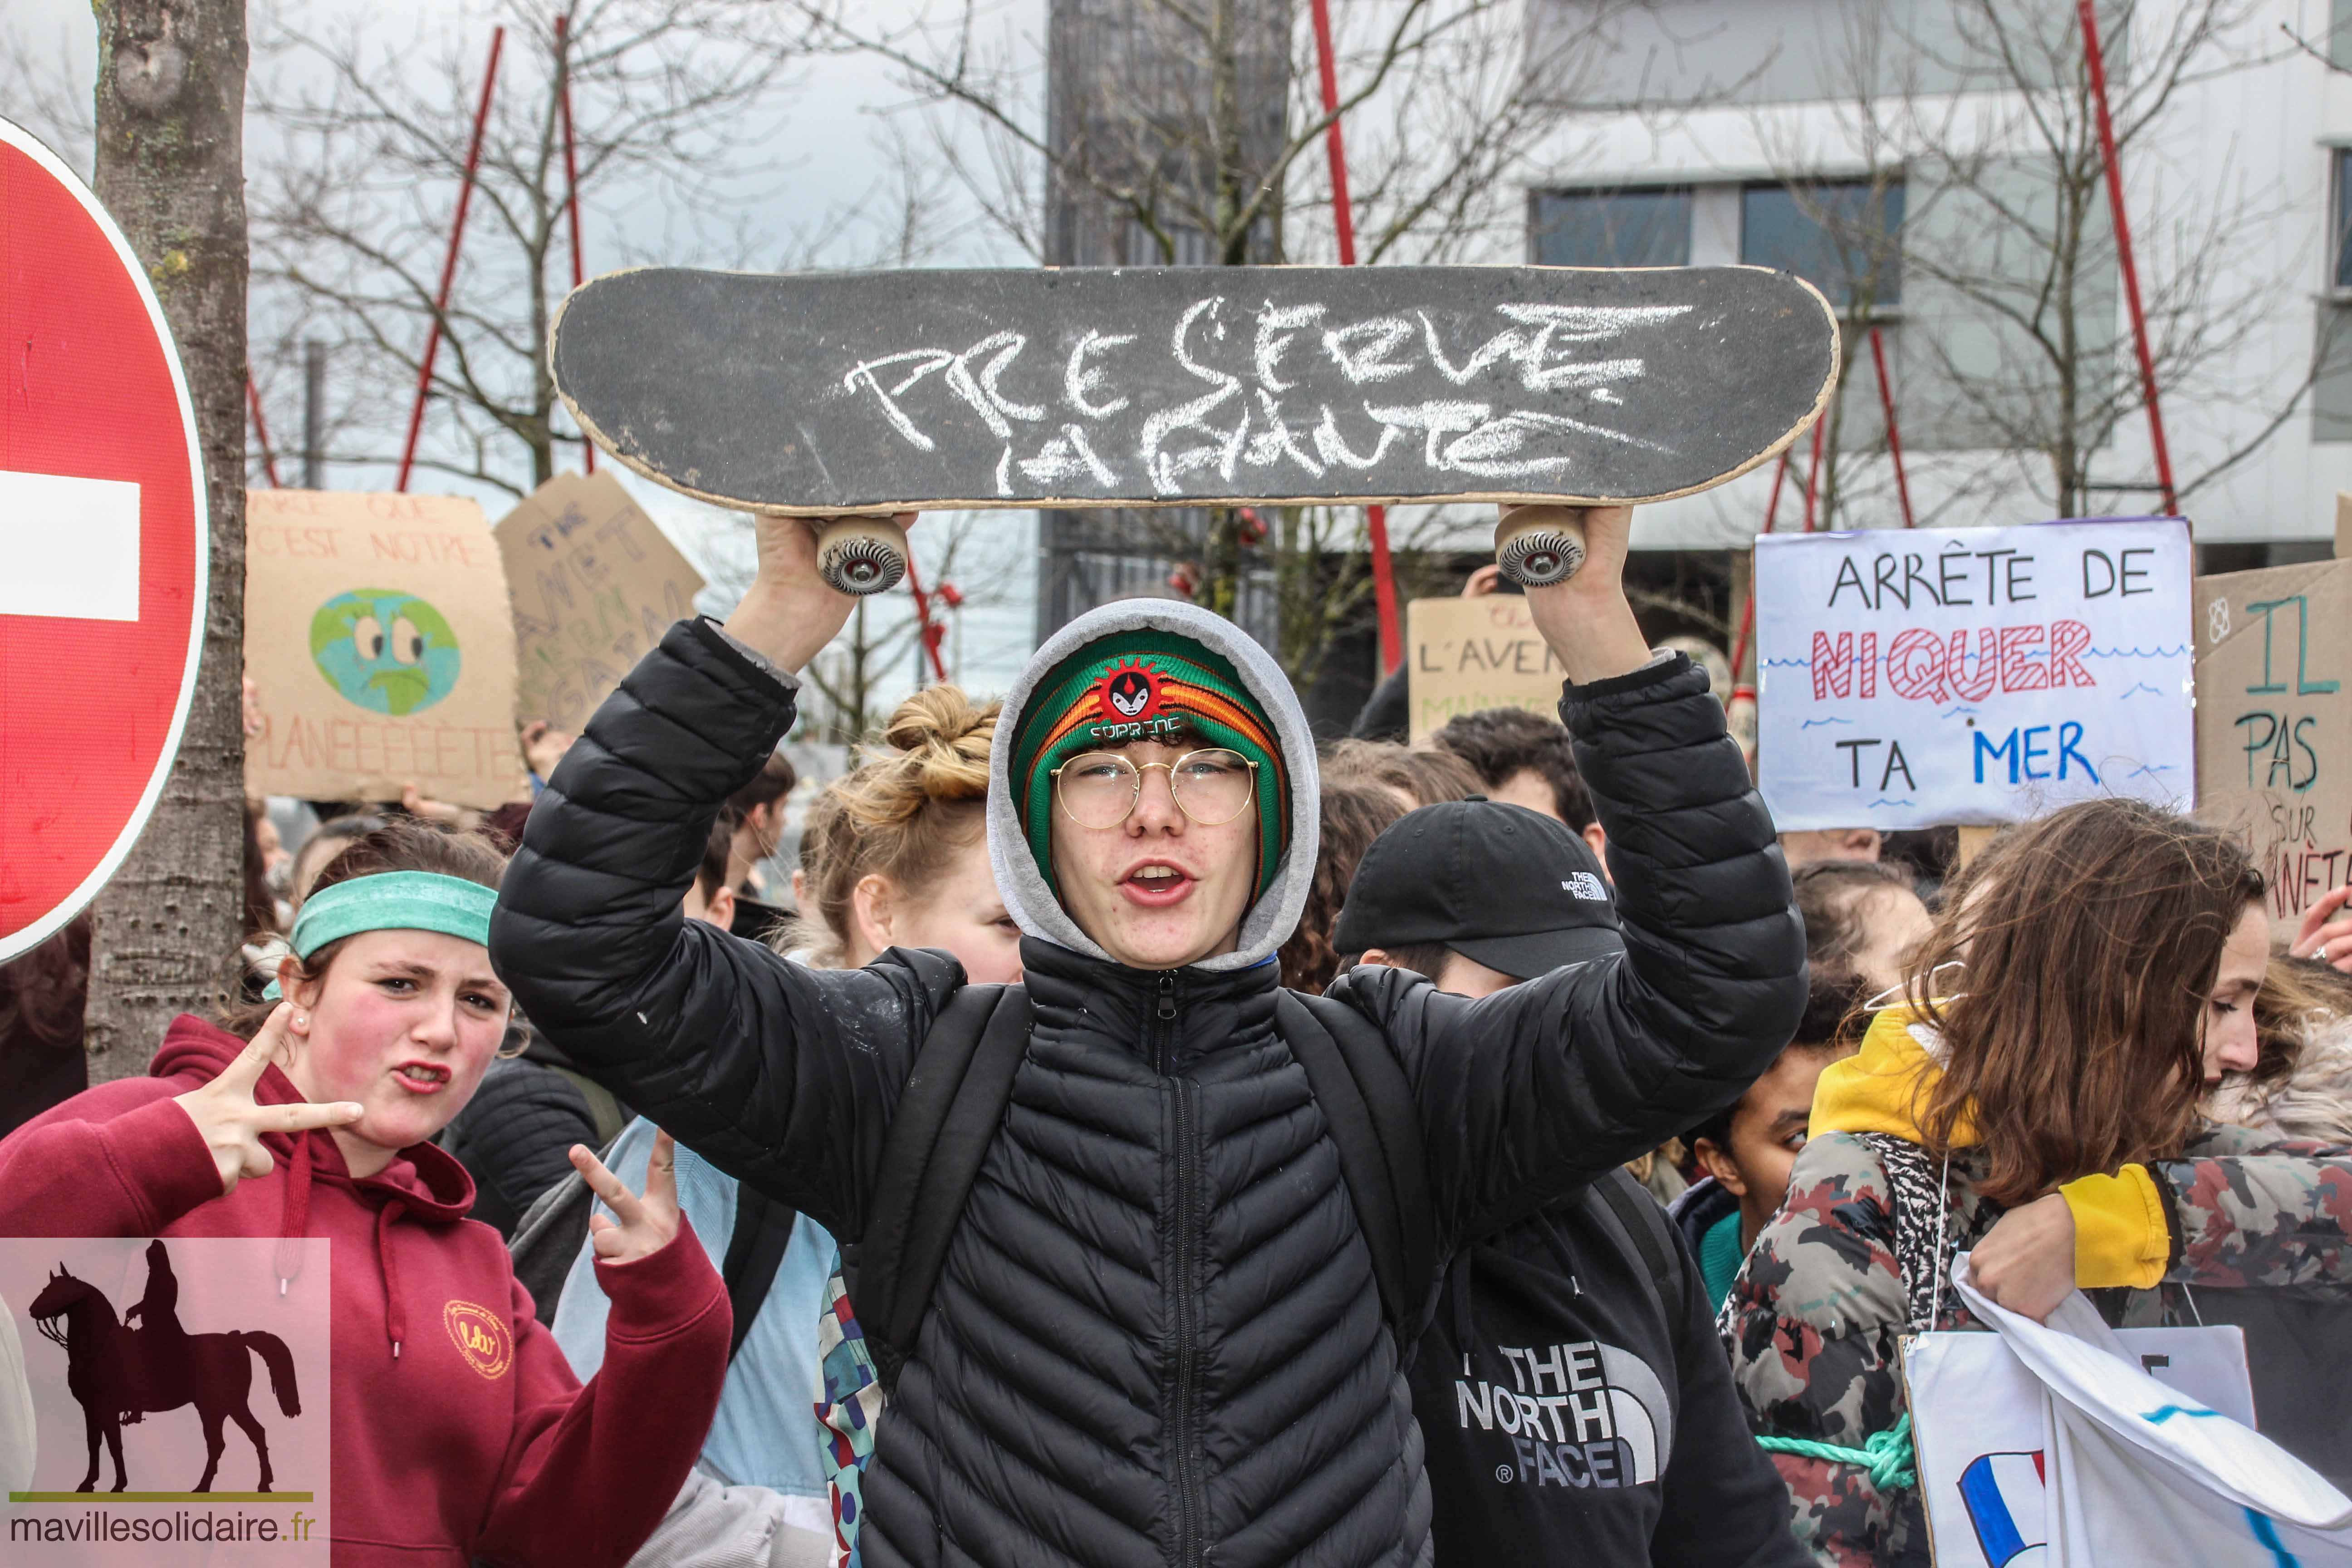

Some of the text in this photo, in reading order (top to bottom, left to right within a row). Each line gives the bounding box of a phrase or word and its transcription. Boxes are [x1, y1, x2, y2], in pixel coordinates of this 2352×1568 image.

[1827, 539, 2155, 610] ARRÊTE DE
[1810, 619, 2097, 705] NIQUER
[2245, 594, 2341, 696] IL
[1835, 720, 2100, 791] TA MER
[2234, 710, 2318, 792] PAS
[2271, 804, 2318, 844] SUR
[1561, 881, 1591, 891] NORTH
[1571, 872, 1589, 882] THE
[1572, 890, 1595, 901] FACE
[1498, 1341, 1603, 1394] THE
[1455, 1388, 1612, 1443] NORTH
[1511, 1435, 1619, 1488] FACE
